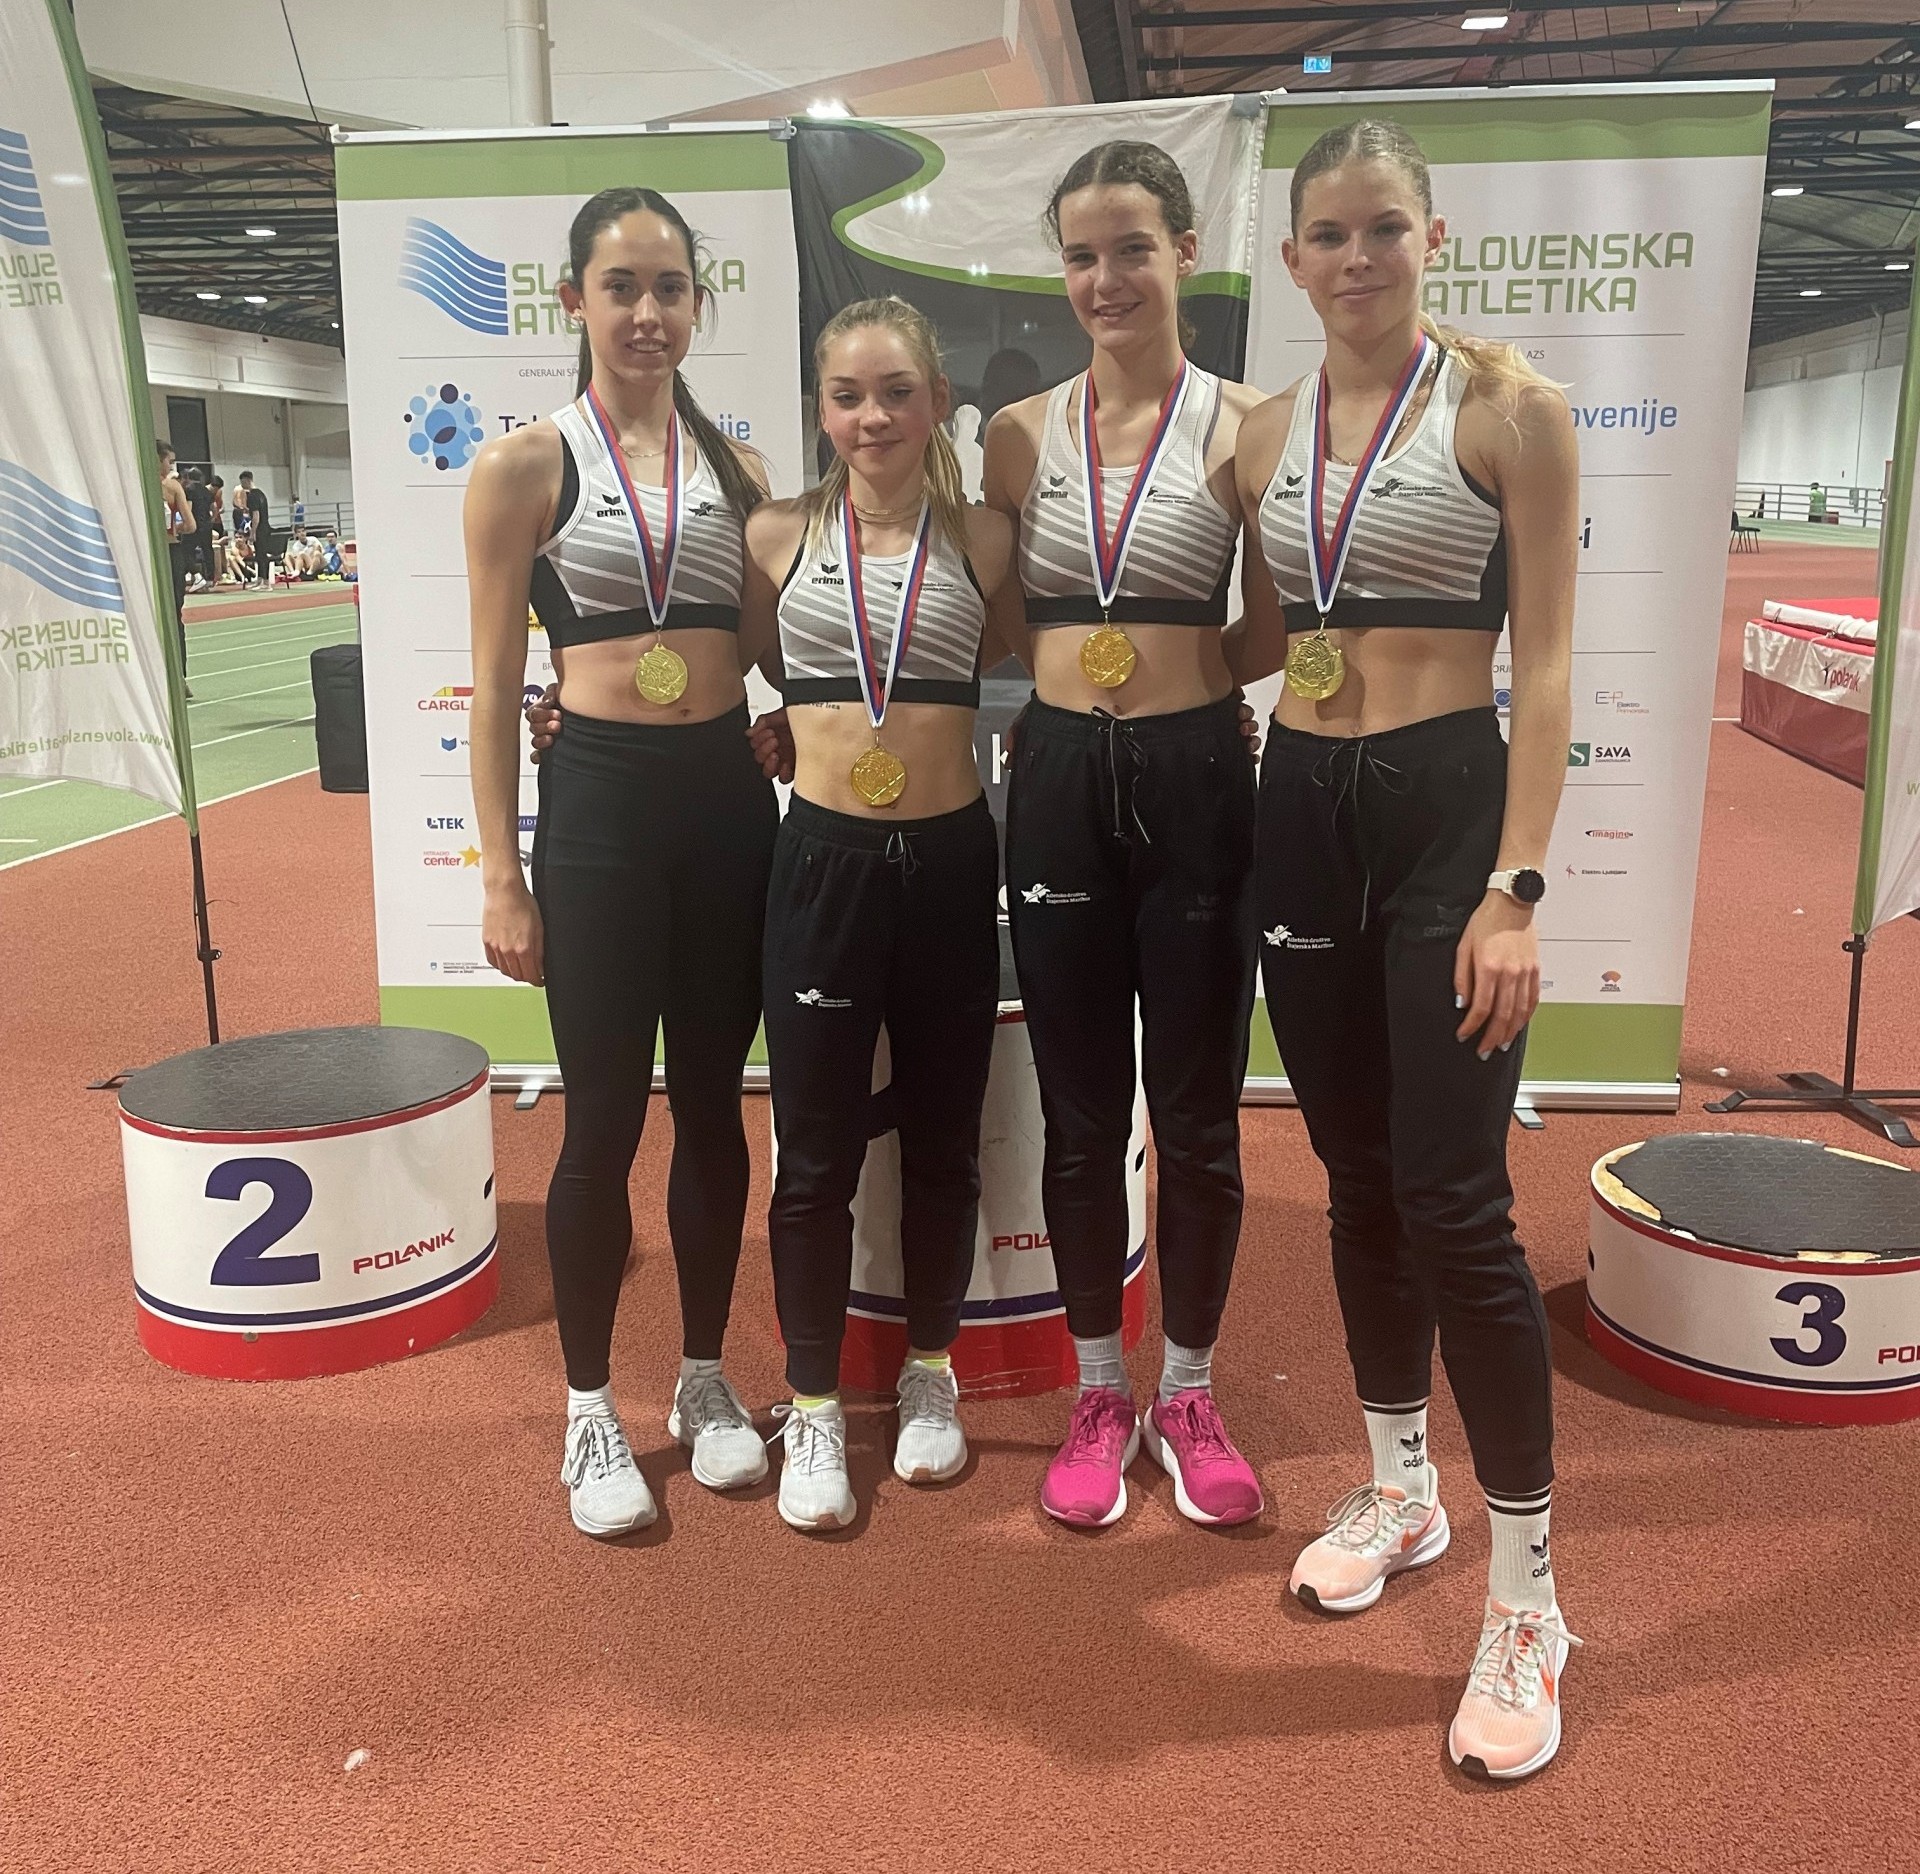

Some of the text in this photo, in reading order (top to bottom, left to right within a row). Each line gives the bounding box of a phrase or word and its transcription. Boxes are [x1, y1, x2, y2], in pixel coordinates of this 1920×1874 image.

[1422, 277, 1637, 315] ATLETIKA
[1527, 350, 1545, 360] AZS
[519, 368, 565, 378] GENERALNI
[1040, 489, 1068, 499] erima
[1274, 489, 1304, 500] erima
[811, 575, 844, 585] erima
[418, 700, 469, 711] CARGL
[1595, 746, 1631, 758] SAVA
[424, 857, 462, 866] center
[205, 1157, 321, 1285] 2
[353, 1228, 456, 1275] POLANIK
[1769, 1281, 1847, 1366] 3
